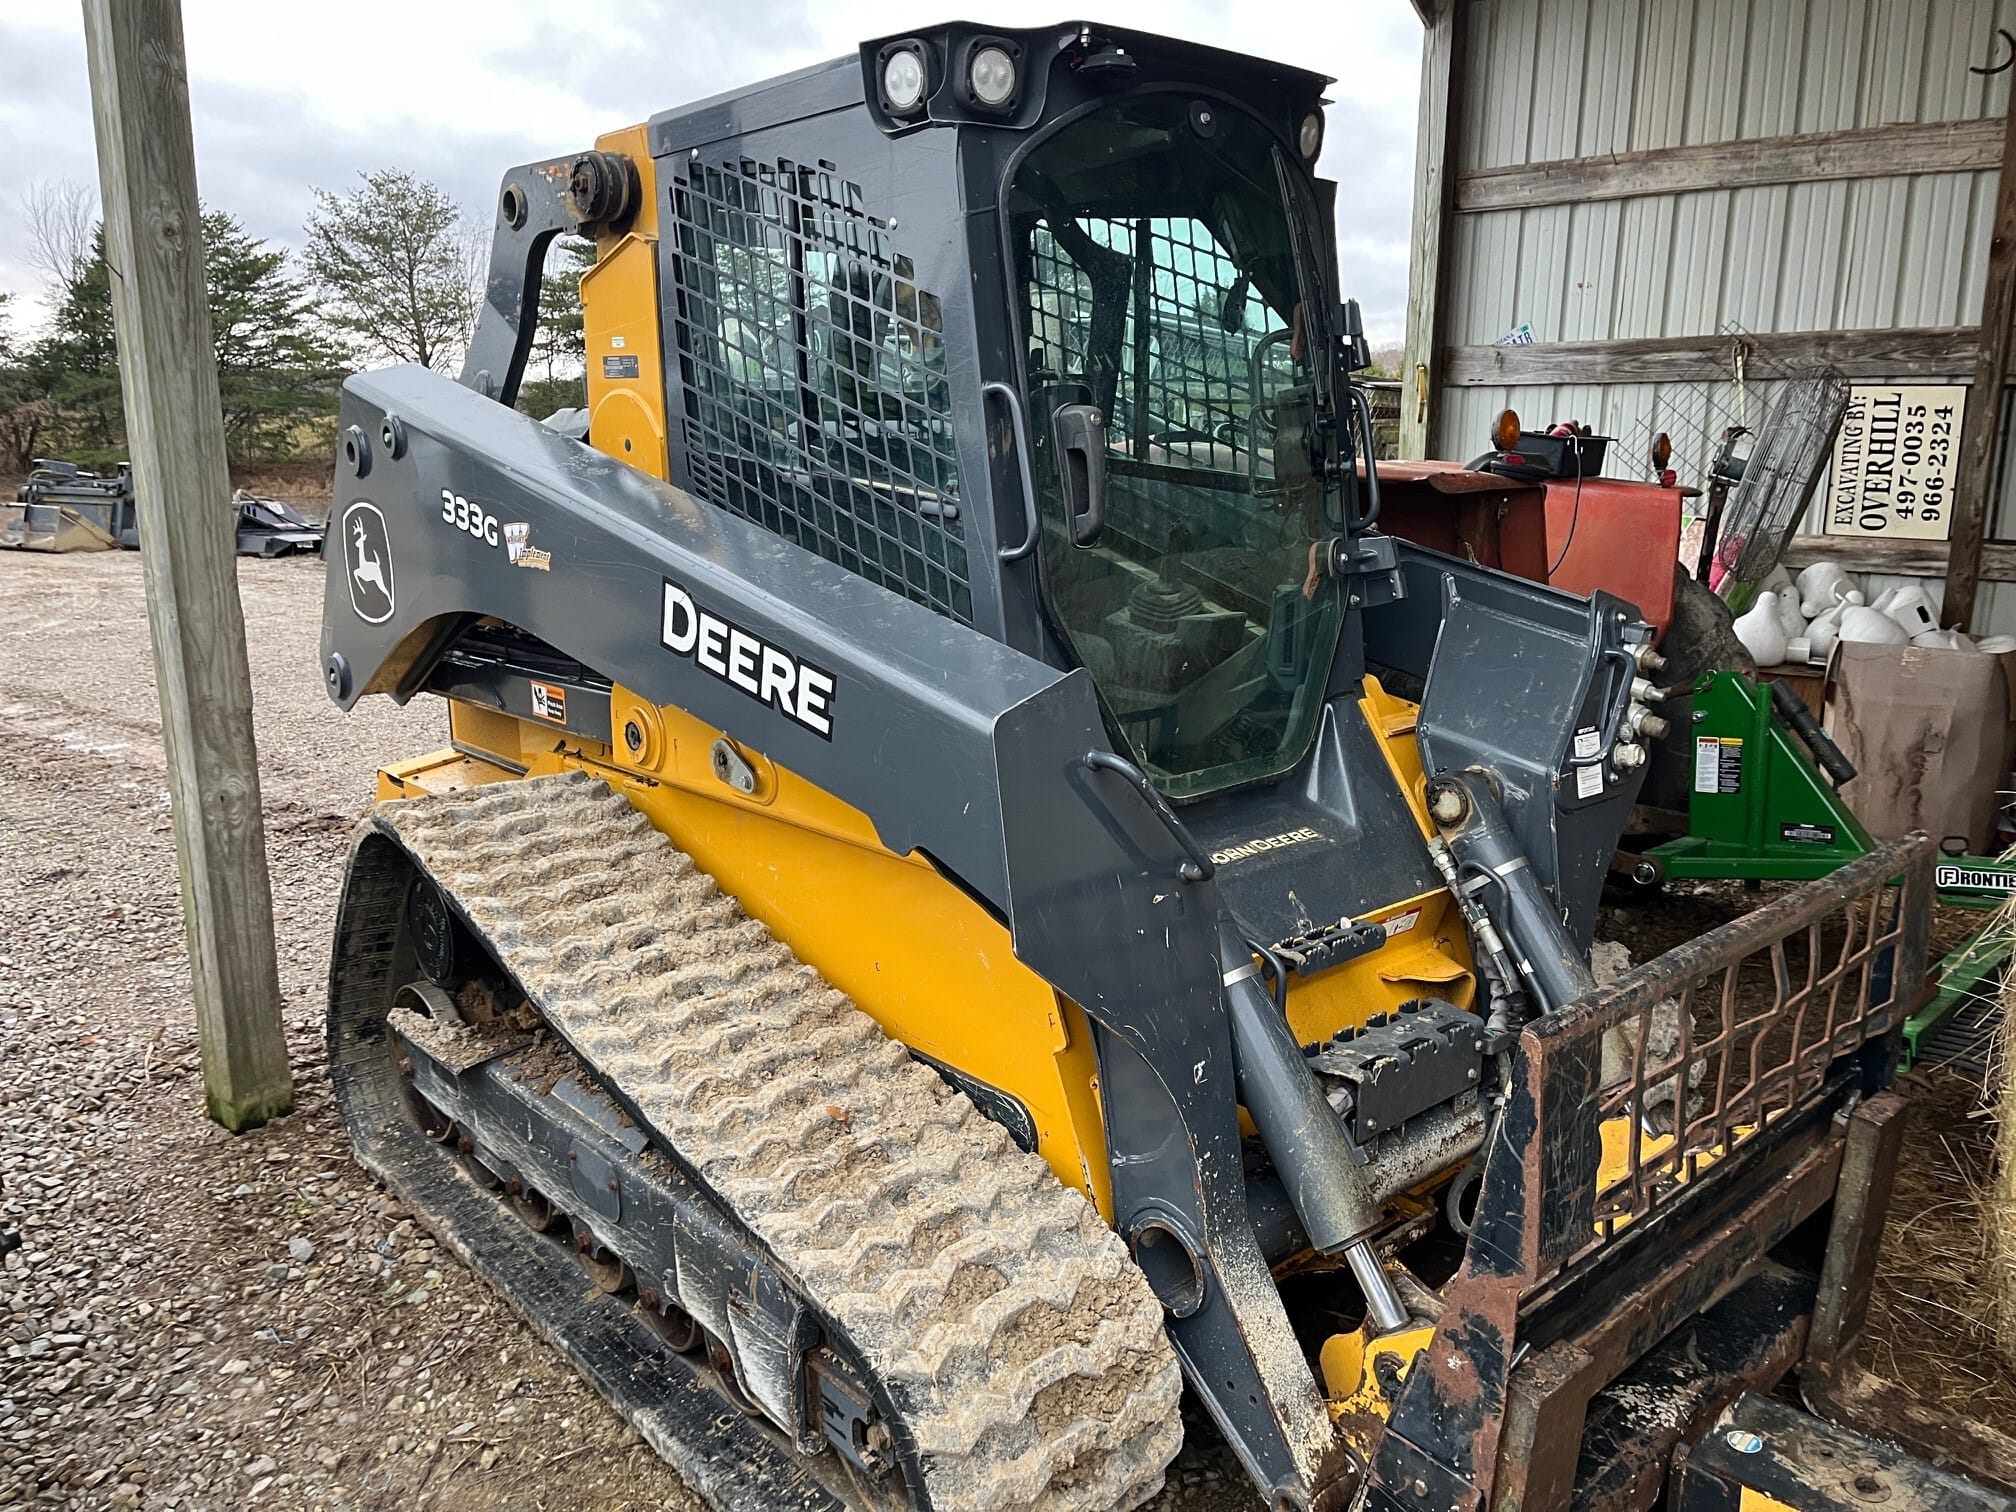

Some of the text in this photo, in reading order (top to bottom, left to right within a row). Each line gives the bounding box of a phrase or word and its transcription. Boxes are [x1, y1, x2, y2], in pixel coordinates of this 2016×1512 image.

[441, 488, 499, 547] 333G
[1834, 396, 1867, 525] EXCAVATING BY:
[1859, 393, 1903, 531] OVERHILL
[1895, 405, 1927, 520] 497-0035
[1920, 405, 1954, 522] 966-2324
[662, 582, 834, 735] DEERE
[1250, 827, 1319, 852] DEERE
[1937, 866, 2016, 889] FRONTIE
